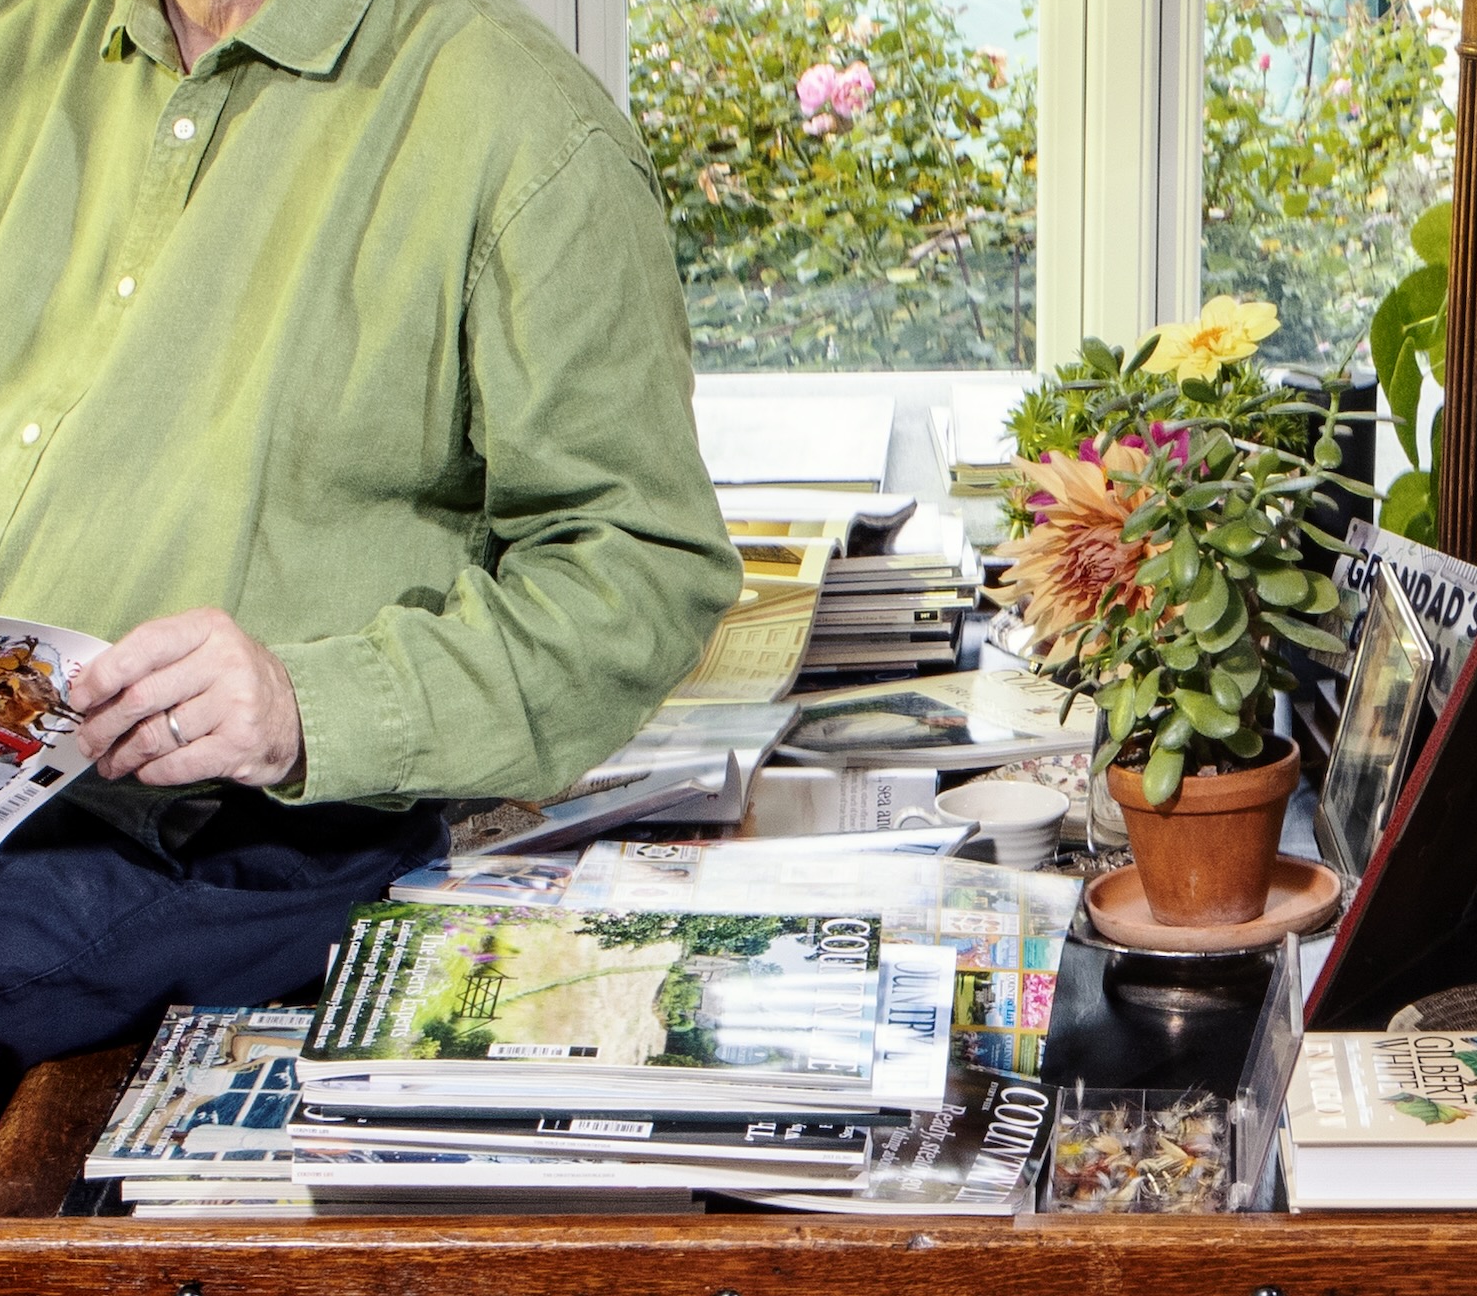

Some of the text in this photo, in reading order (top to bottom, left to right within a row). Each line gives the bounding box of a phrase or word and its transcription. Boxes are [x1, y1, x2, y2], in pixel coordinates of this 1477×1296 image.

[417, 927, 448, 959] The
[385, 993, 425, 1044] Experts
[1371, 1036, 1419, 1091] WHITE
[1413, 1035, 1468, 1106] GILBERT
[918, 1102, 966, 1144] Ready,
[966, 1086, 1049, 1194] COUNTRY
